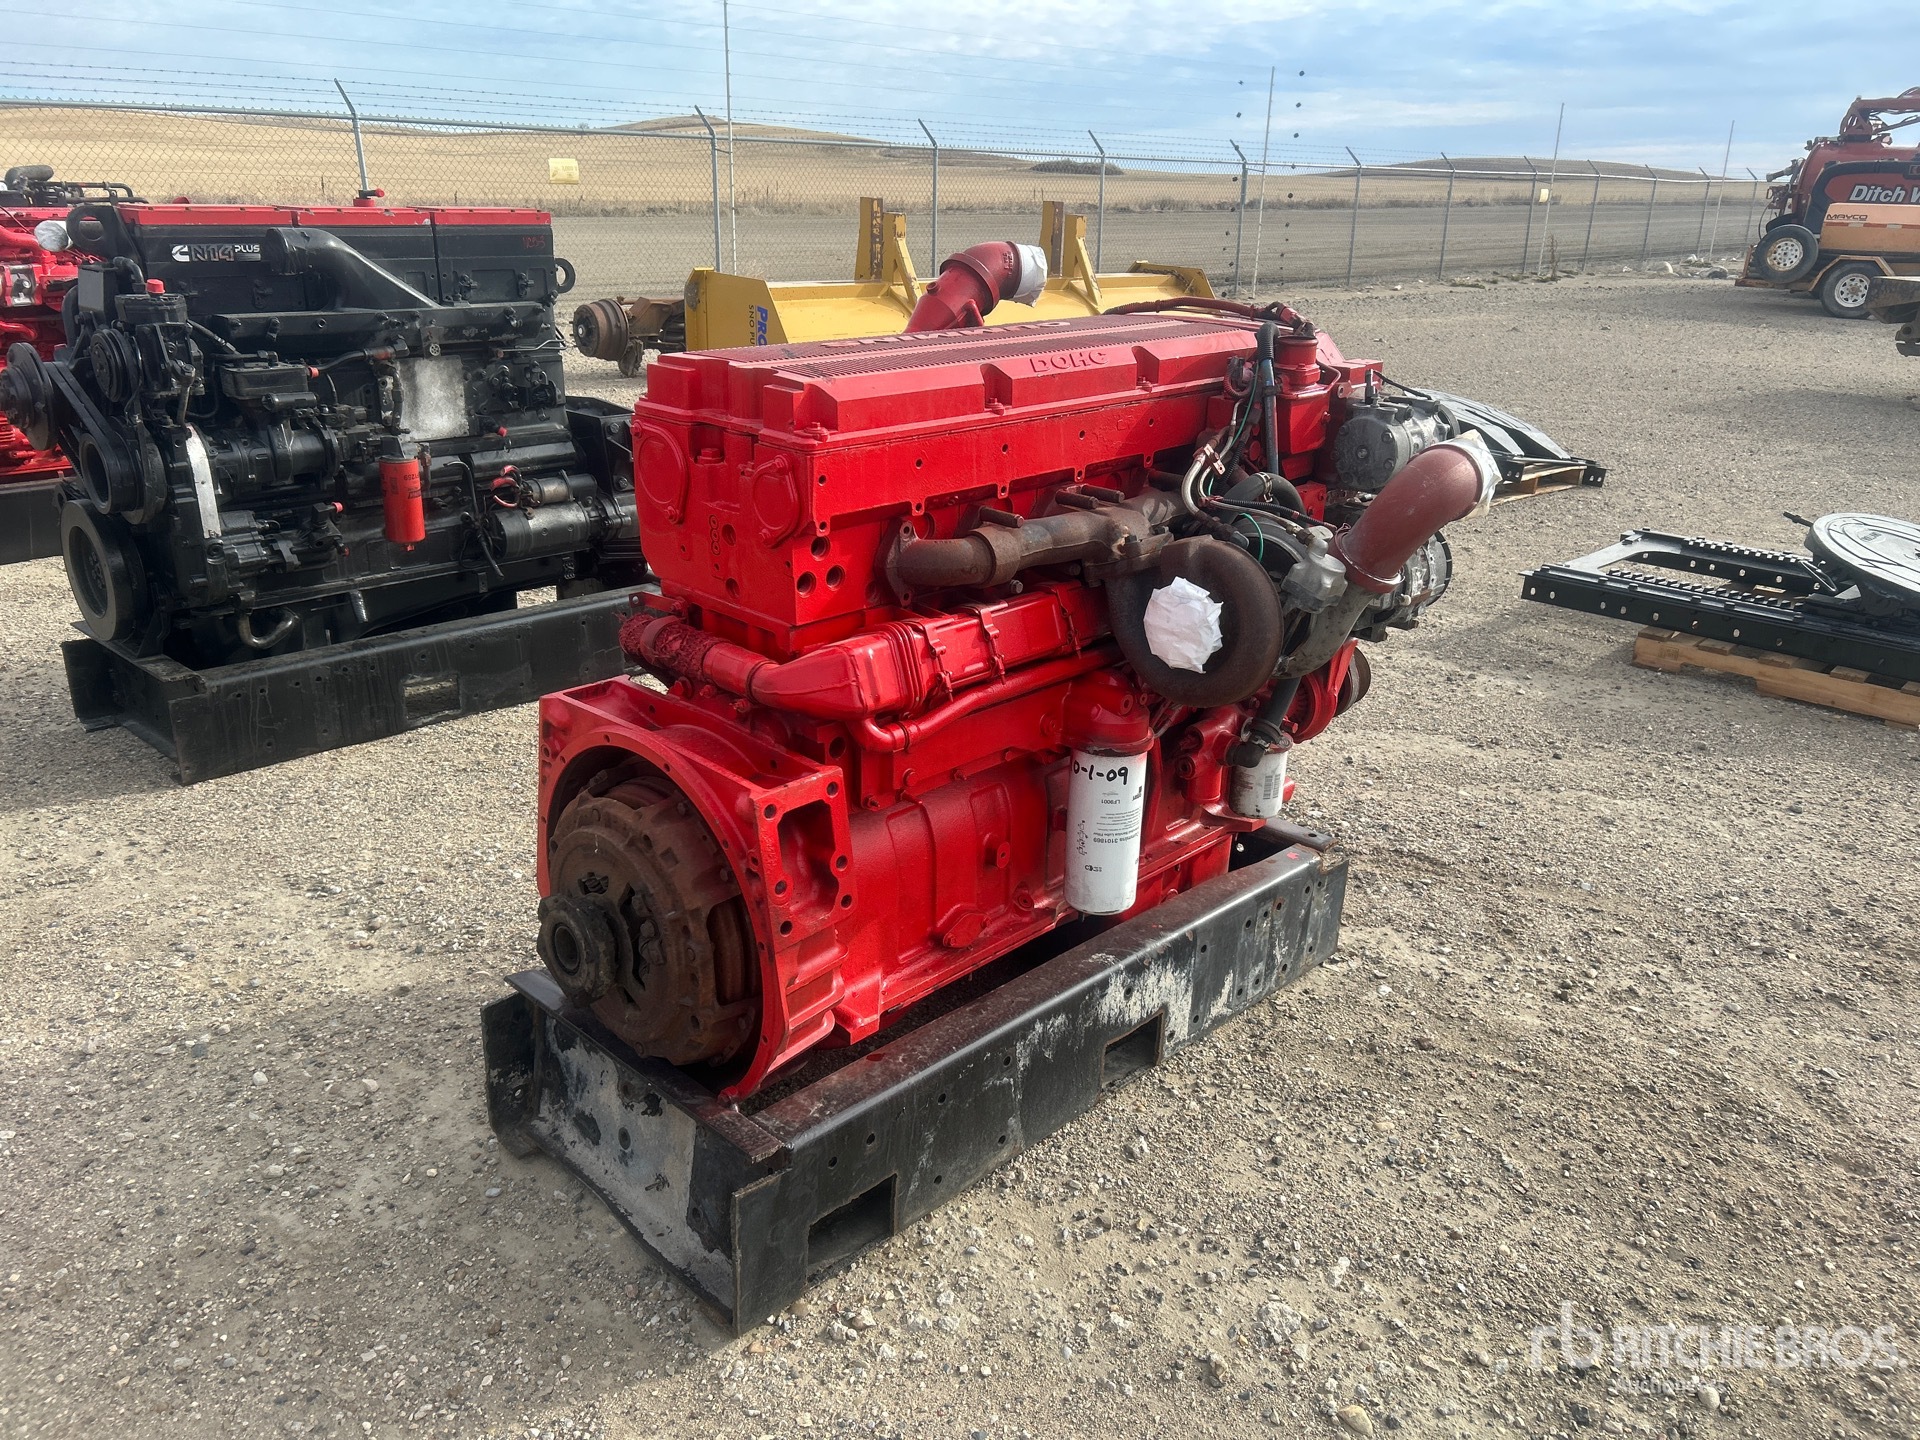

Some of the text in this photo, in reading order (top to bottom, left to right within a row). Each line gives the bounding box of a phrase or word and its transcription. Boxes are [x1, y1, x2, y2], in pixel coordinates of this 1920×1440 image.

[1849, 185, 1906, 202] Ditch
[1826, 213, 1868, 221] MAYCO
[191, 244, 234, 261] N14
[234, 244, 260, 253] PLUS
[1029, 351, 1108, 373] DOHC
